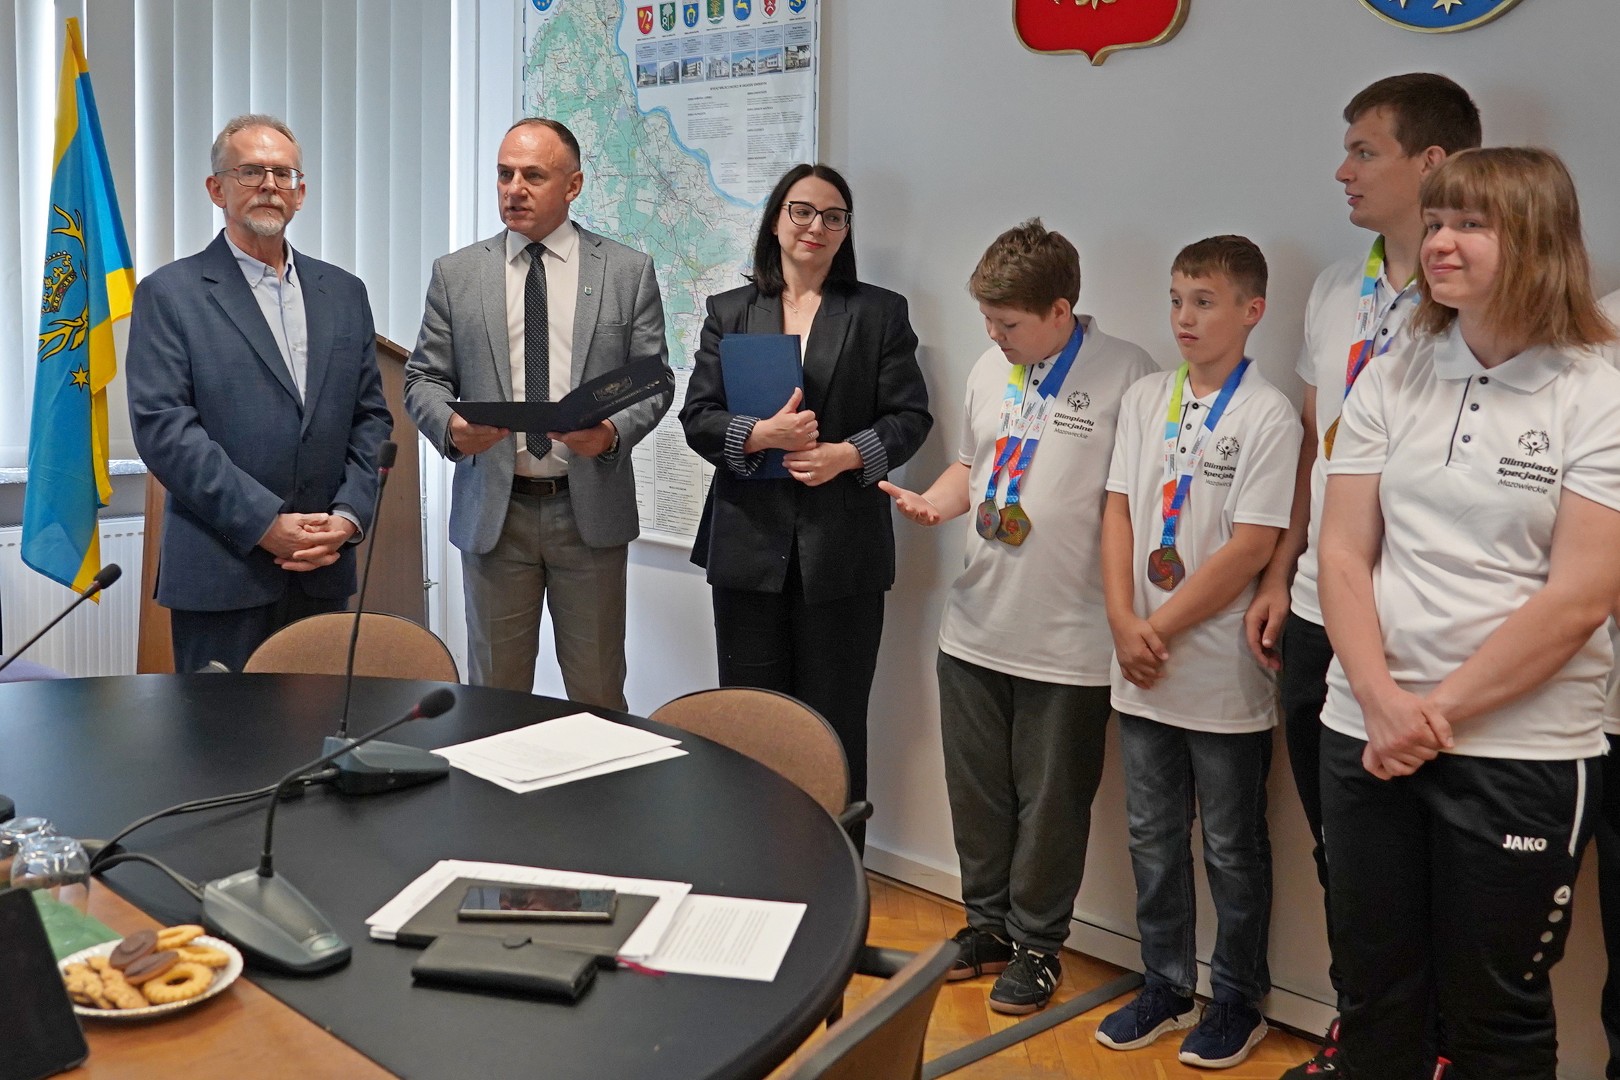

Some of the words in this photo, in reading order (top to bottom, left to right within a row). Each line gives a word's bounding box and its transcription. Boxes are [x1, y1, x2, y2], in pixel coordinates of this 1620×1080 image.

[1053, 420, 1093, 432] Specjalne
[1054, 412, 1095, 427] Olimpiady
[1500, 457, 1558, 475] Olimpiady
[1497, 467, 1556, 484] Specjalne
[1498, 479, 1548, 494] Mazowieckie
[1502, 834, 1547, 851] JAKO
